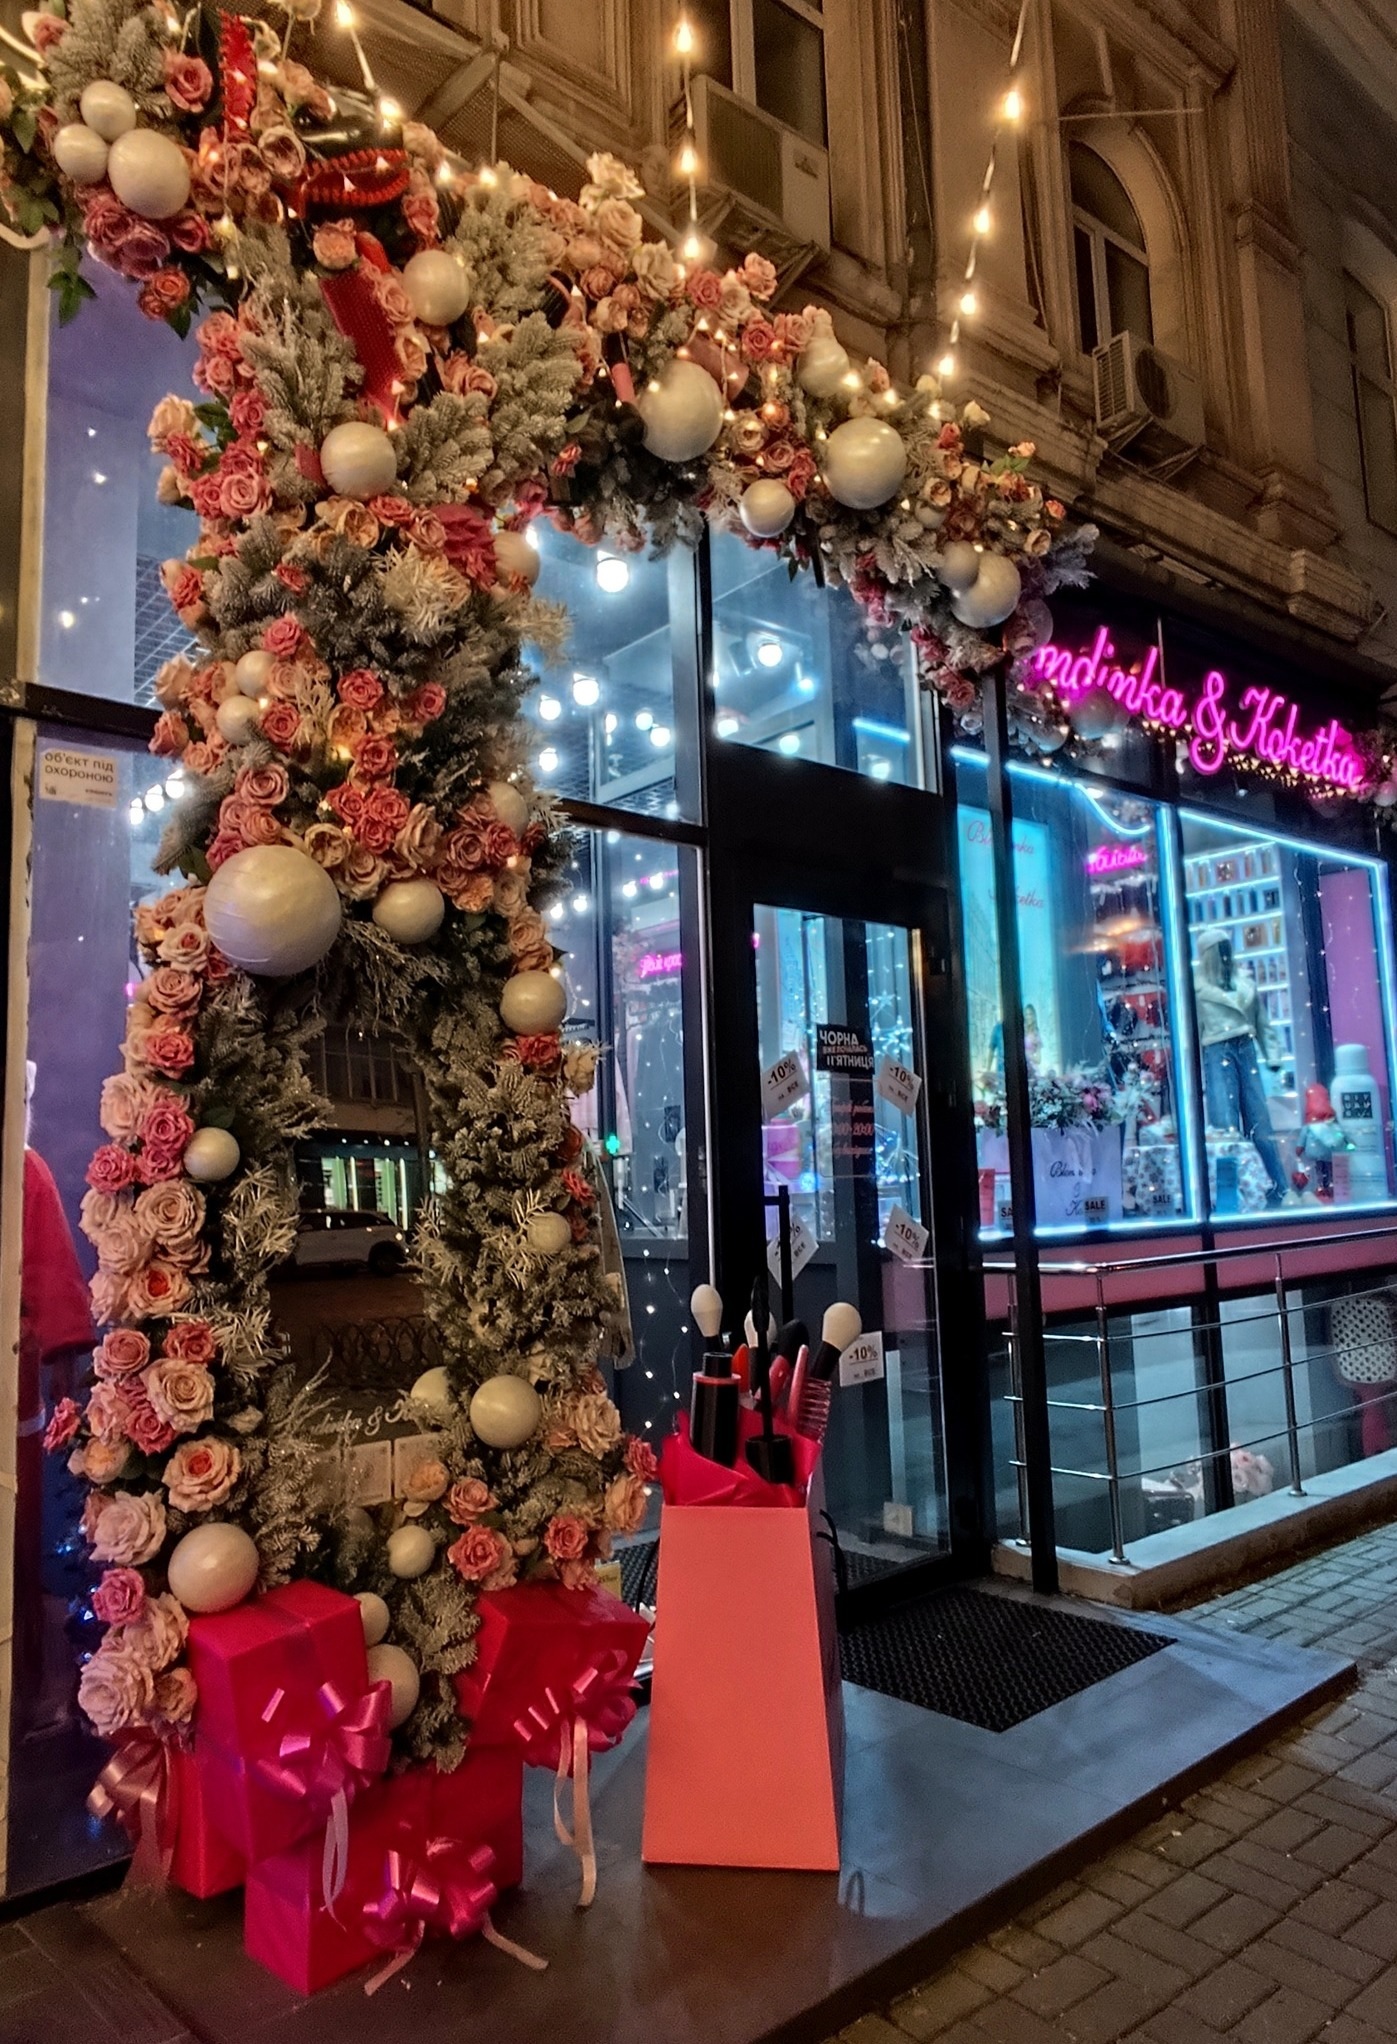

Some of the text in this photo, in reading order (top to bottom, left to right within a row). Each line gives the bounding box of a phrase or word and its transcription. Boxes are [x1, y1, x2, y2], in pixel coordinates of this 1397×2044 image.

[1190, 671, 1226, 775] &
[1230, 686, 1361, 785] Koketka
[45, 752, 114, 772] об'єкт під
[45, 765, 114, 783] охороною
[819, 1029, 859, 1046] ЧОРНА
[767, 1058, 796, 1085] -10%
[889, 1065, 915, 1091] -10%
[1084, 1200, 1106, 1211] SALE
[1153, 1194, 1171, 1204] SALE
[895, 1223, 920, 1250] -10%
[849, 1346, 878, 1360] -10%
[364, 1405, 383, 1436] &
